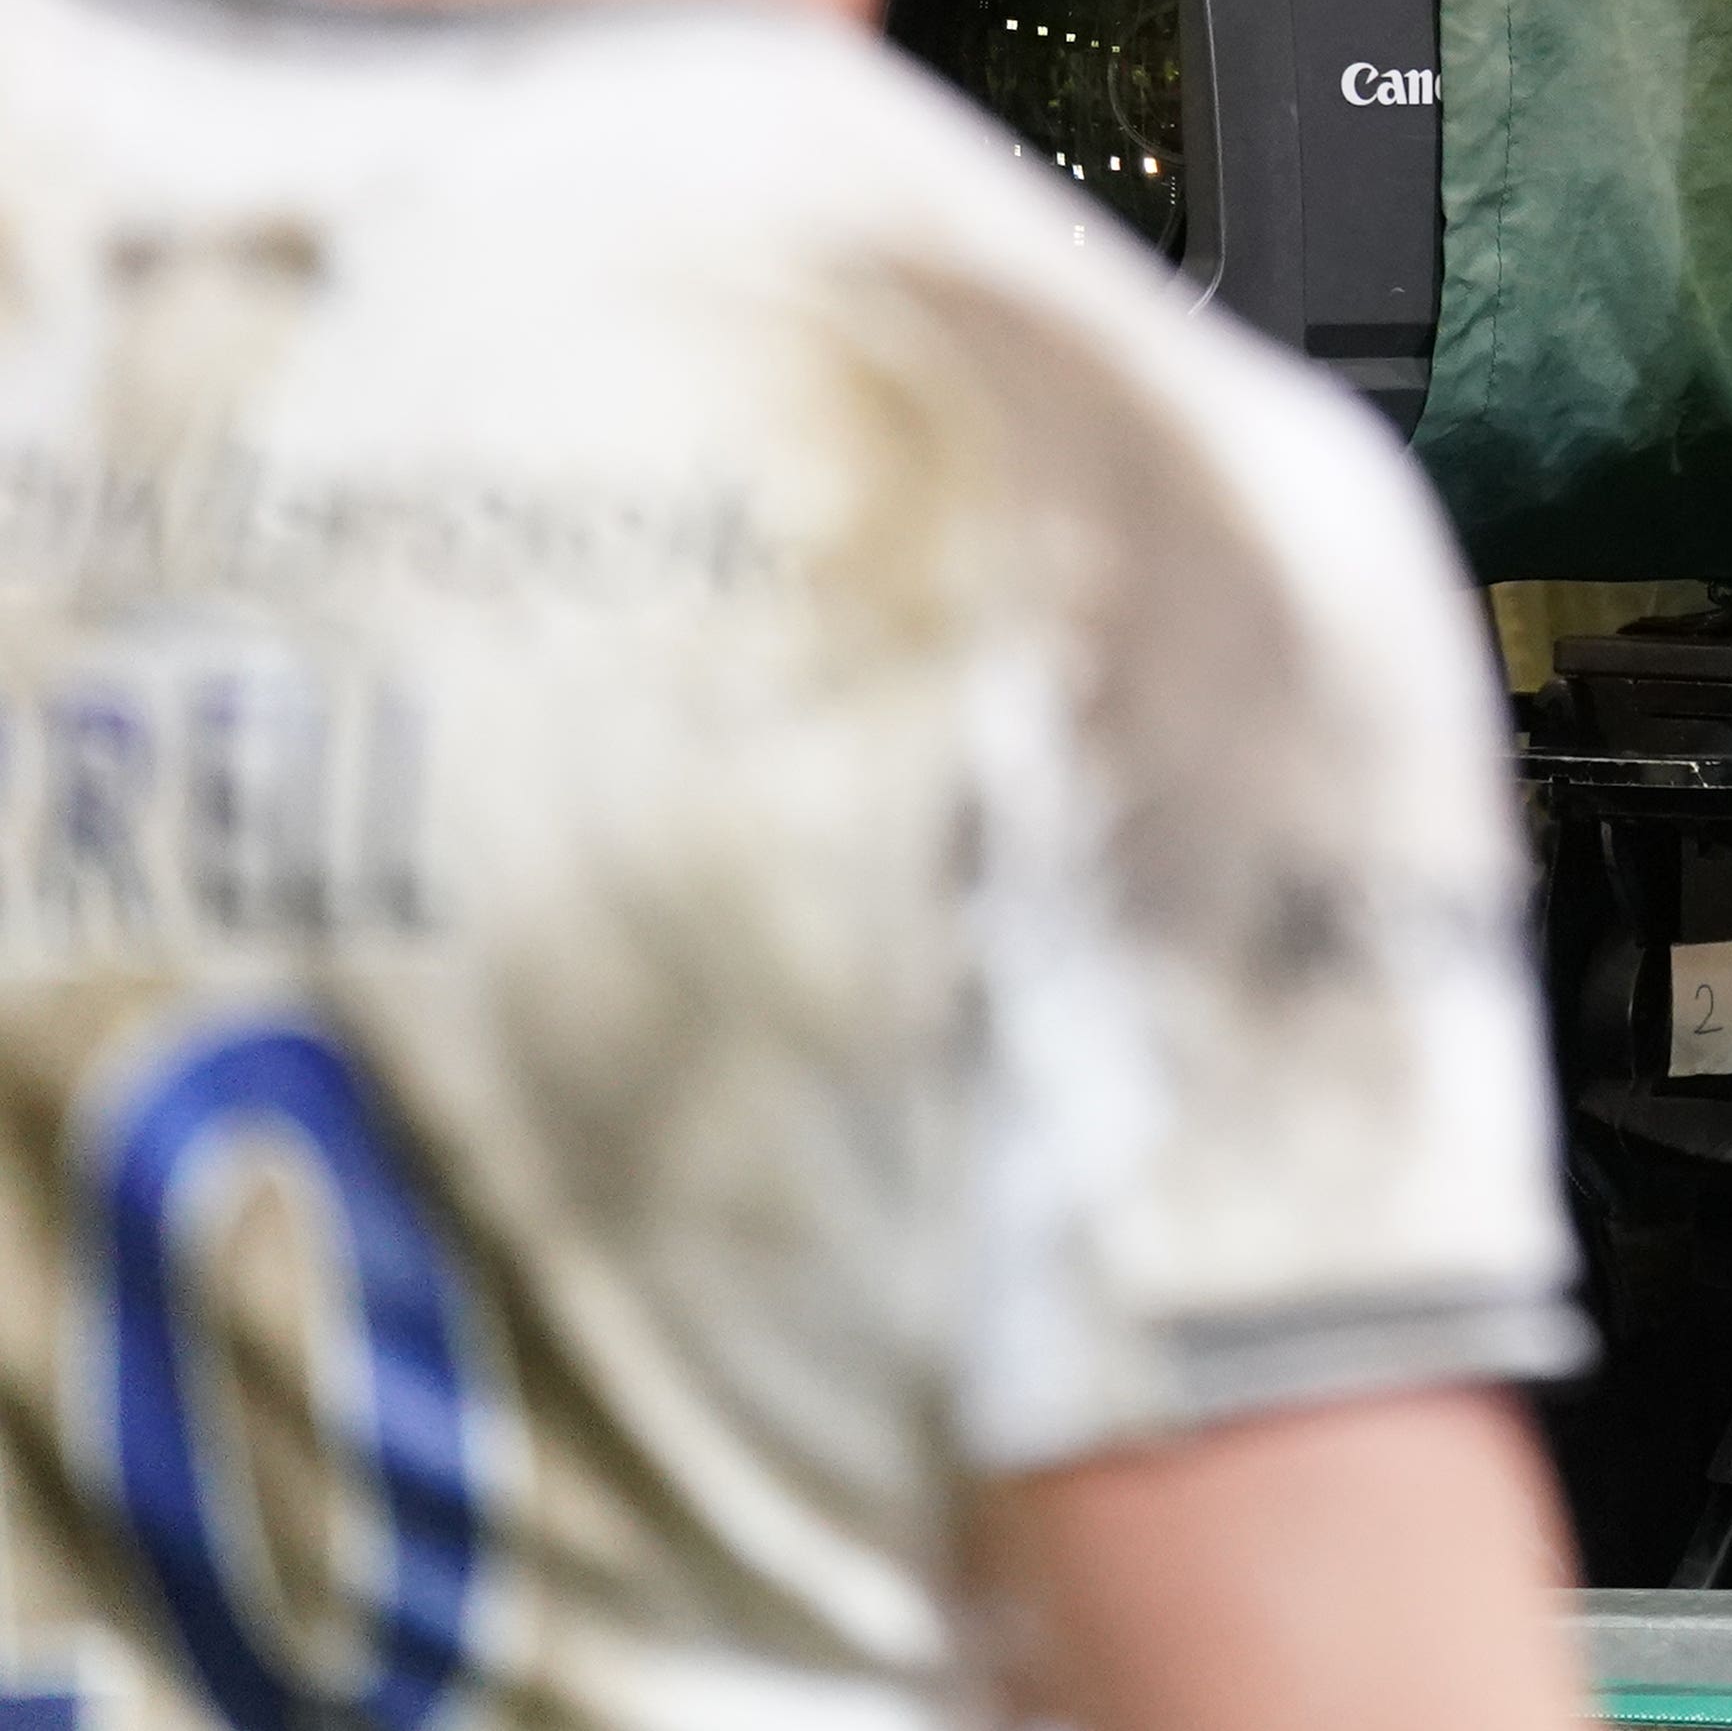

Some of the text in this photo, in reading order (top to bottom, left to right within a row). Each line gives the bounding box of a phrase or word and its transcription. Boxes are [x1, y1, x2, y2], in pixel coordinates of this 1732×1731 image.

[1340, 61, 1440, 106] Can
[0, 666, 435, 938] RELL
[1693, 984, 1724, 1035] 2
[60, 1020, 480, 1731] 0
